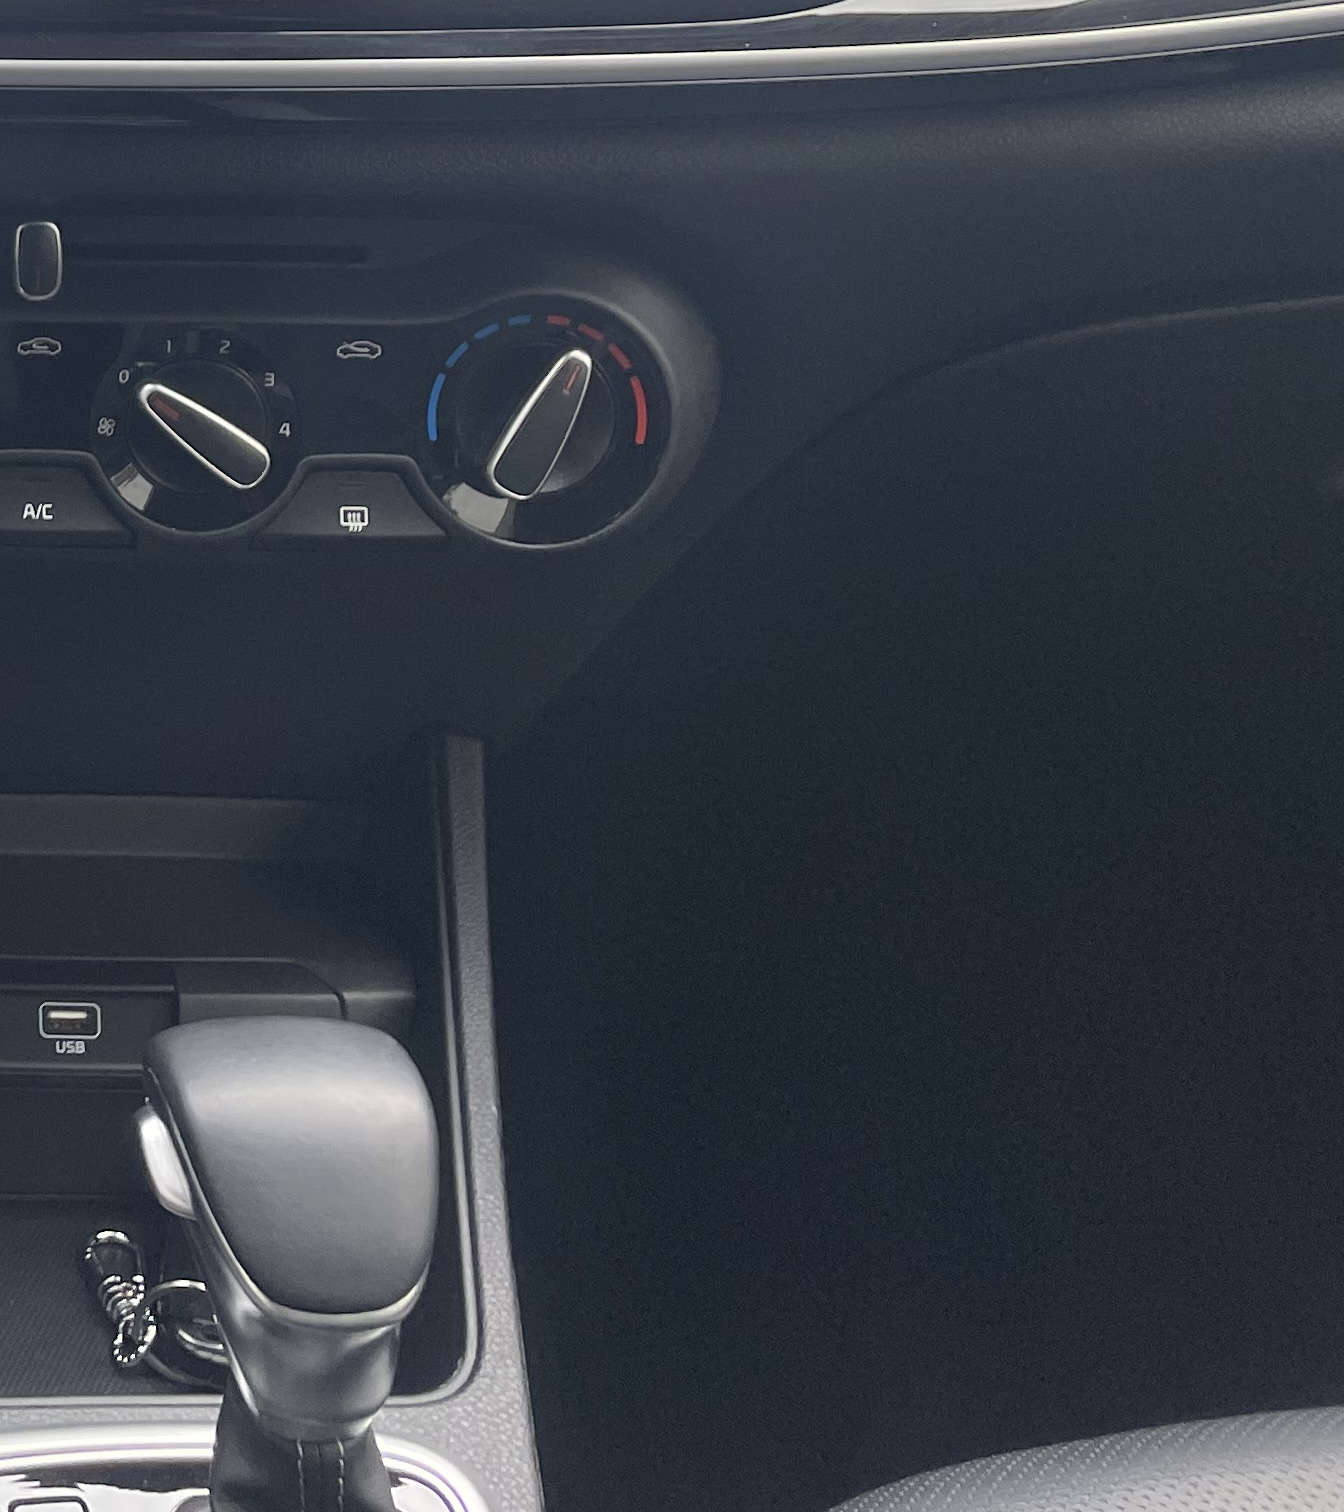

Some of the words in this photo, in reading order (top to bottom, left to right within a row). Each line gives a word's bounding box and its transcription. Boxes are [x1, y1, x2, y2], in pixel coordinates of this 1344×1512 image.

[166, 339, 172, 354] 1
[219, 340, 231, 354] 2
[118, 369, 130, 384] 0
[264, 372, 275, 387] 3
[278, 422, 291, 437] 4
[22, 503, 54, 520] A/C
[55, 1040, 86, 1054] USB
